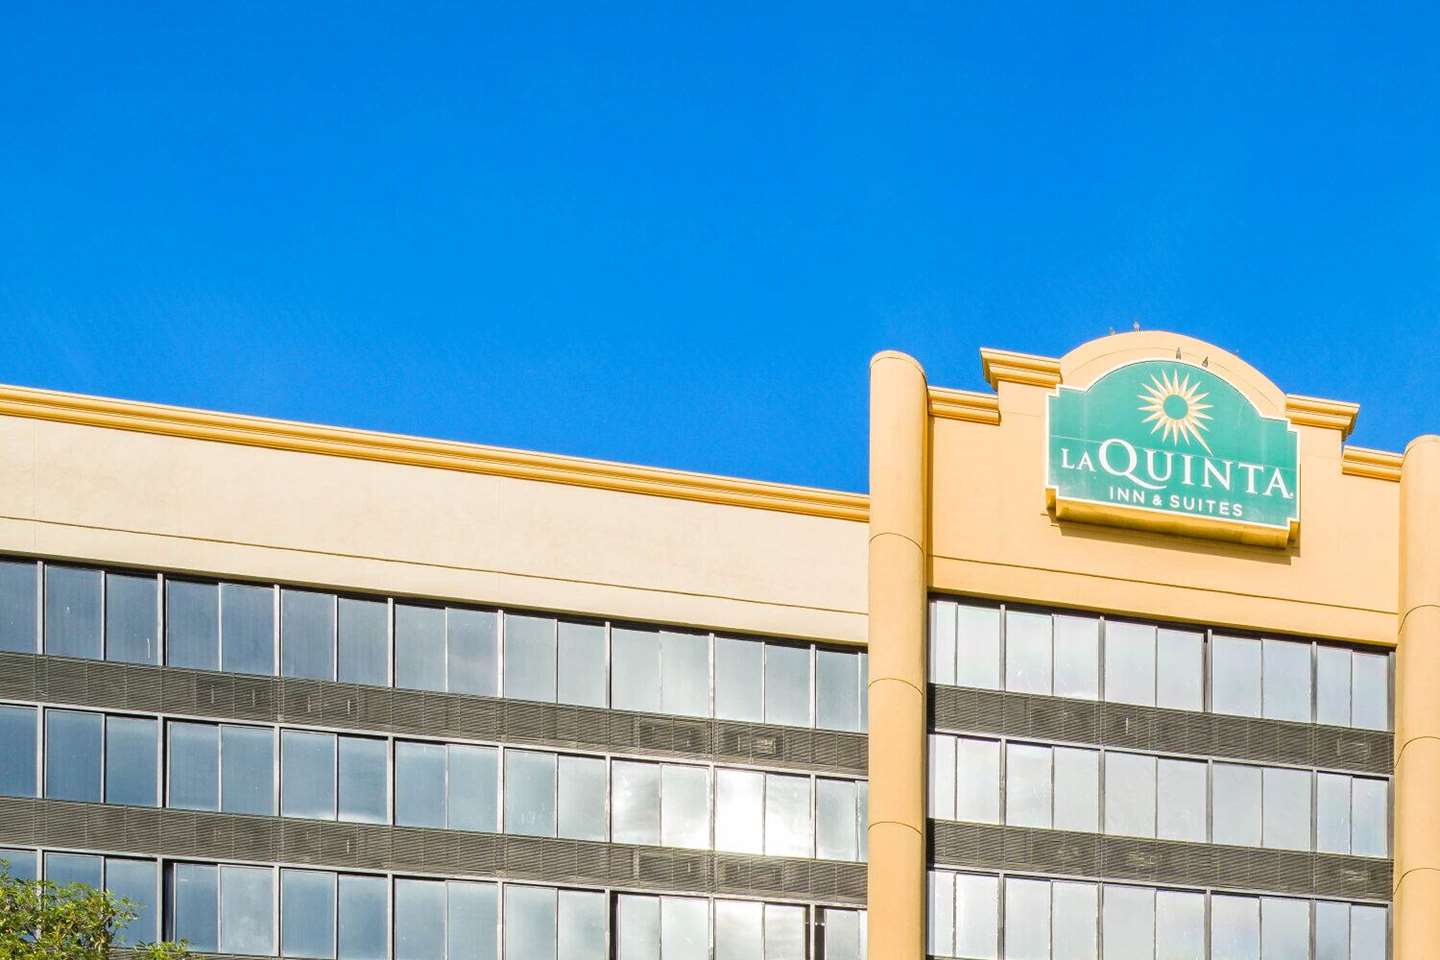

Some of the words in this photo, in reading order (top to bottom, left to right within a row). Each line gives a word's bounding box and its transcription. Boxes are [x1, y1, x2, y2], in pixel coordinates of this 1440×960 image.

[1060, 448, 1096, 472] LA
[1099, 438, 1292, 499] QUINTA
[1109, 486, 1145, 505] INN
[1152, 494, 1162, 506] &
[1169, 495, 1244, 516] SUITES
